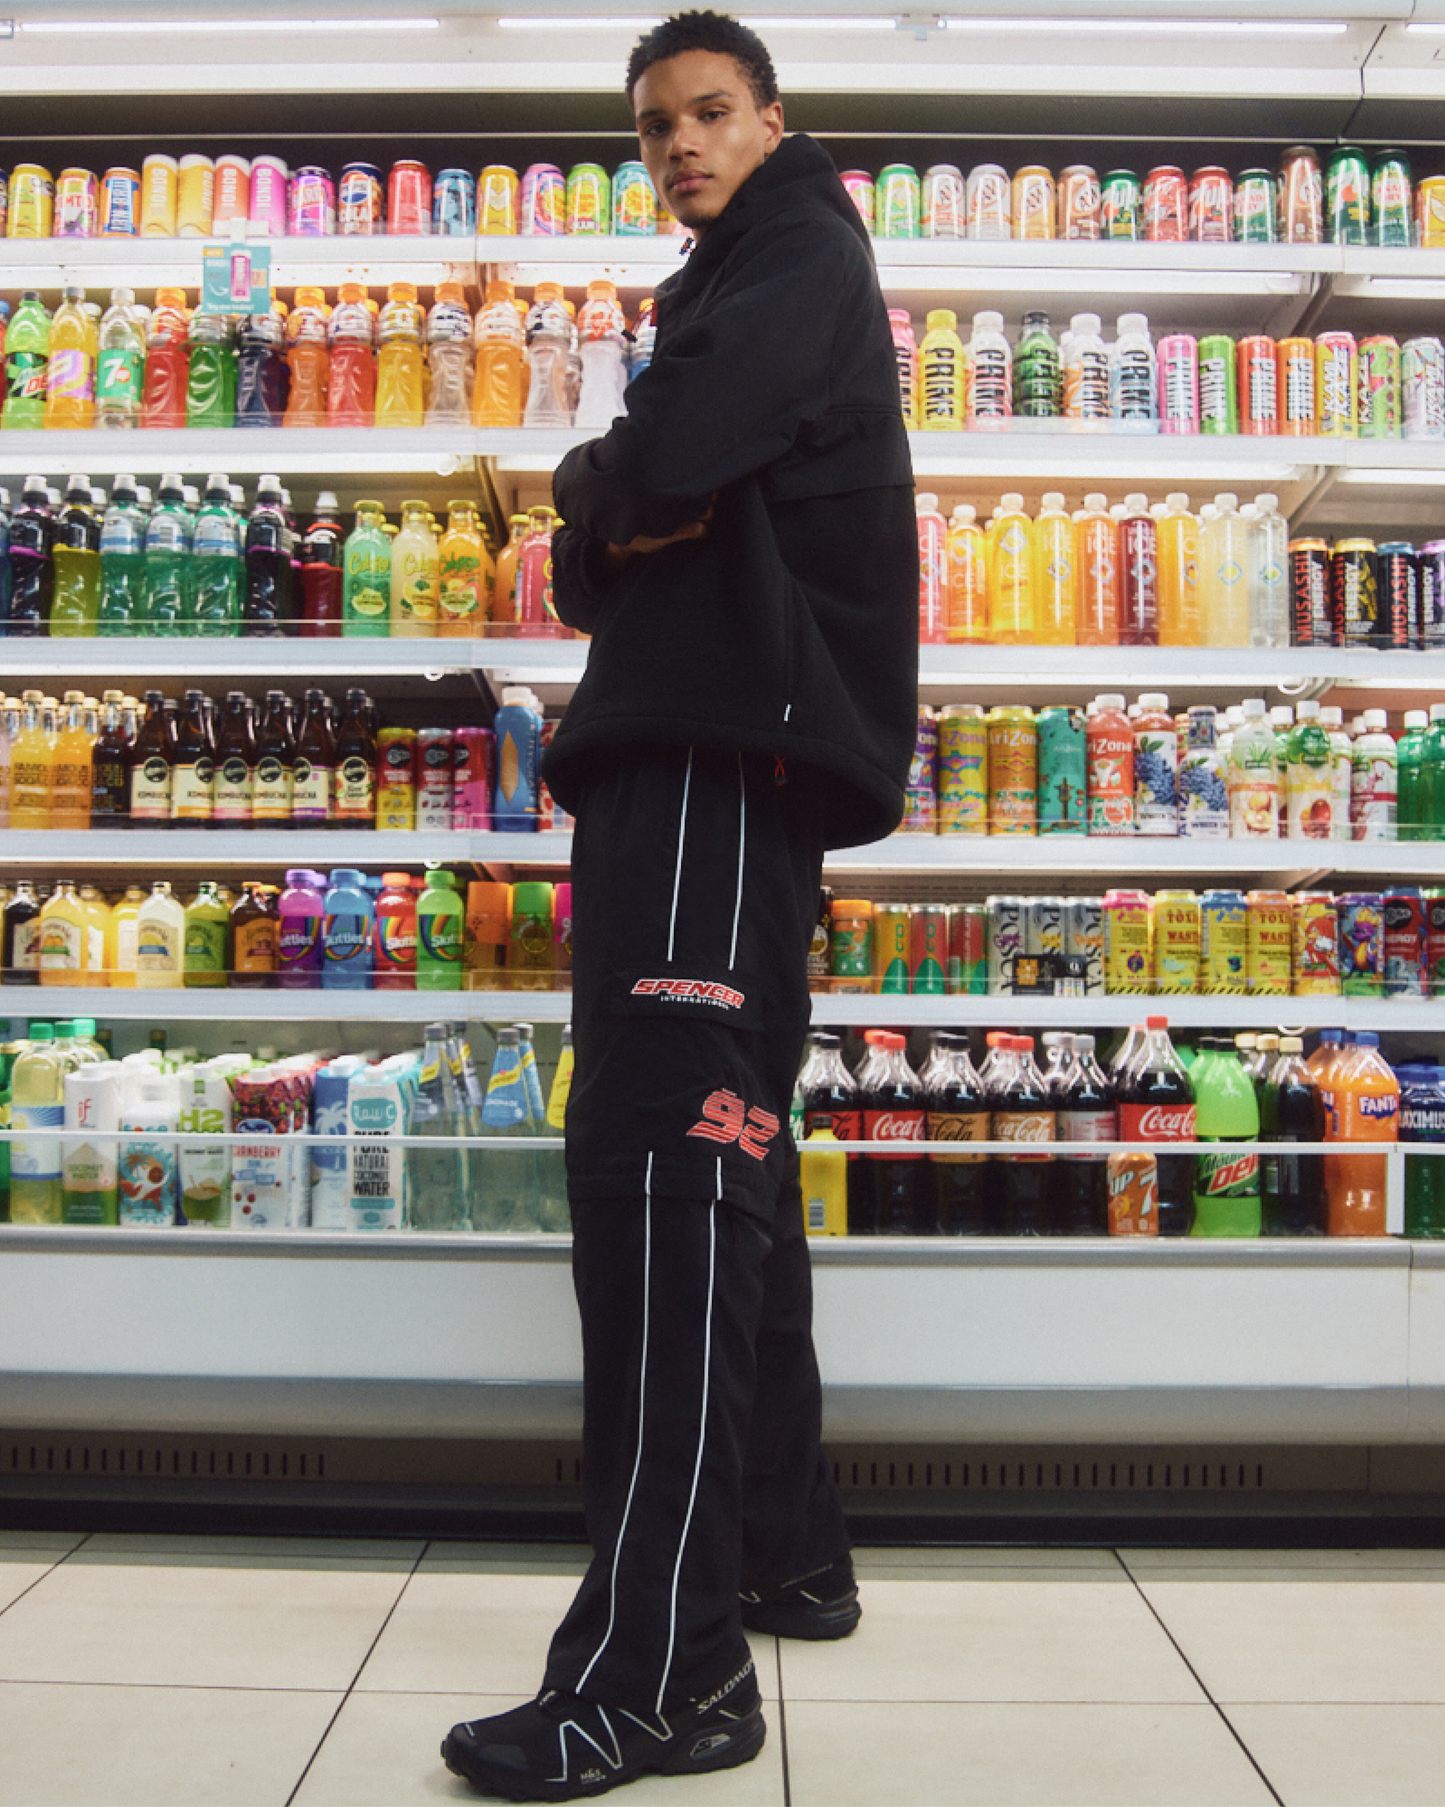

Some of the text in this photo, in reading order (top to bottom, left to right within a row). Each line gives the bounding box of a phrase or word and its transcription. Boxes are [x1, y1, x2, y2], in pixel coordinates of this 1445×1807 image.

[151, 168, 168, 208] BONDI
[221, 168, 237, 208] BONDI
[256, 168, 272, 208] BONDI
[925, 347, 954, 419] PRIME
[976, 349, 1005, 417] PRIME
[1121, 350, 1150, 418] PRIME
[1167, 357, 1193, 419] PRIME
[1201, 357, 1226, 420] PRIME
[1251, 357, 1276, 420] PRIME
[1288, 357, 1313, 420] PRIME
[1129, 534, 1157, 555] ICE
[1295, 553, 1313, 642] MUSASHI
[1345, 562, 1358, 620] ENERGY
[1391, 557, 1408, 644] MUSASHI
[1423, 567, 1434, 624] ENERGY
[631, 979, 745, 1009] SPENCER
[78, 1099, 92, 1124] if
[686, 1088, 780, 1161] 92
[353, 1182, 390, 1197] WATER
